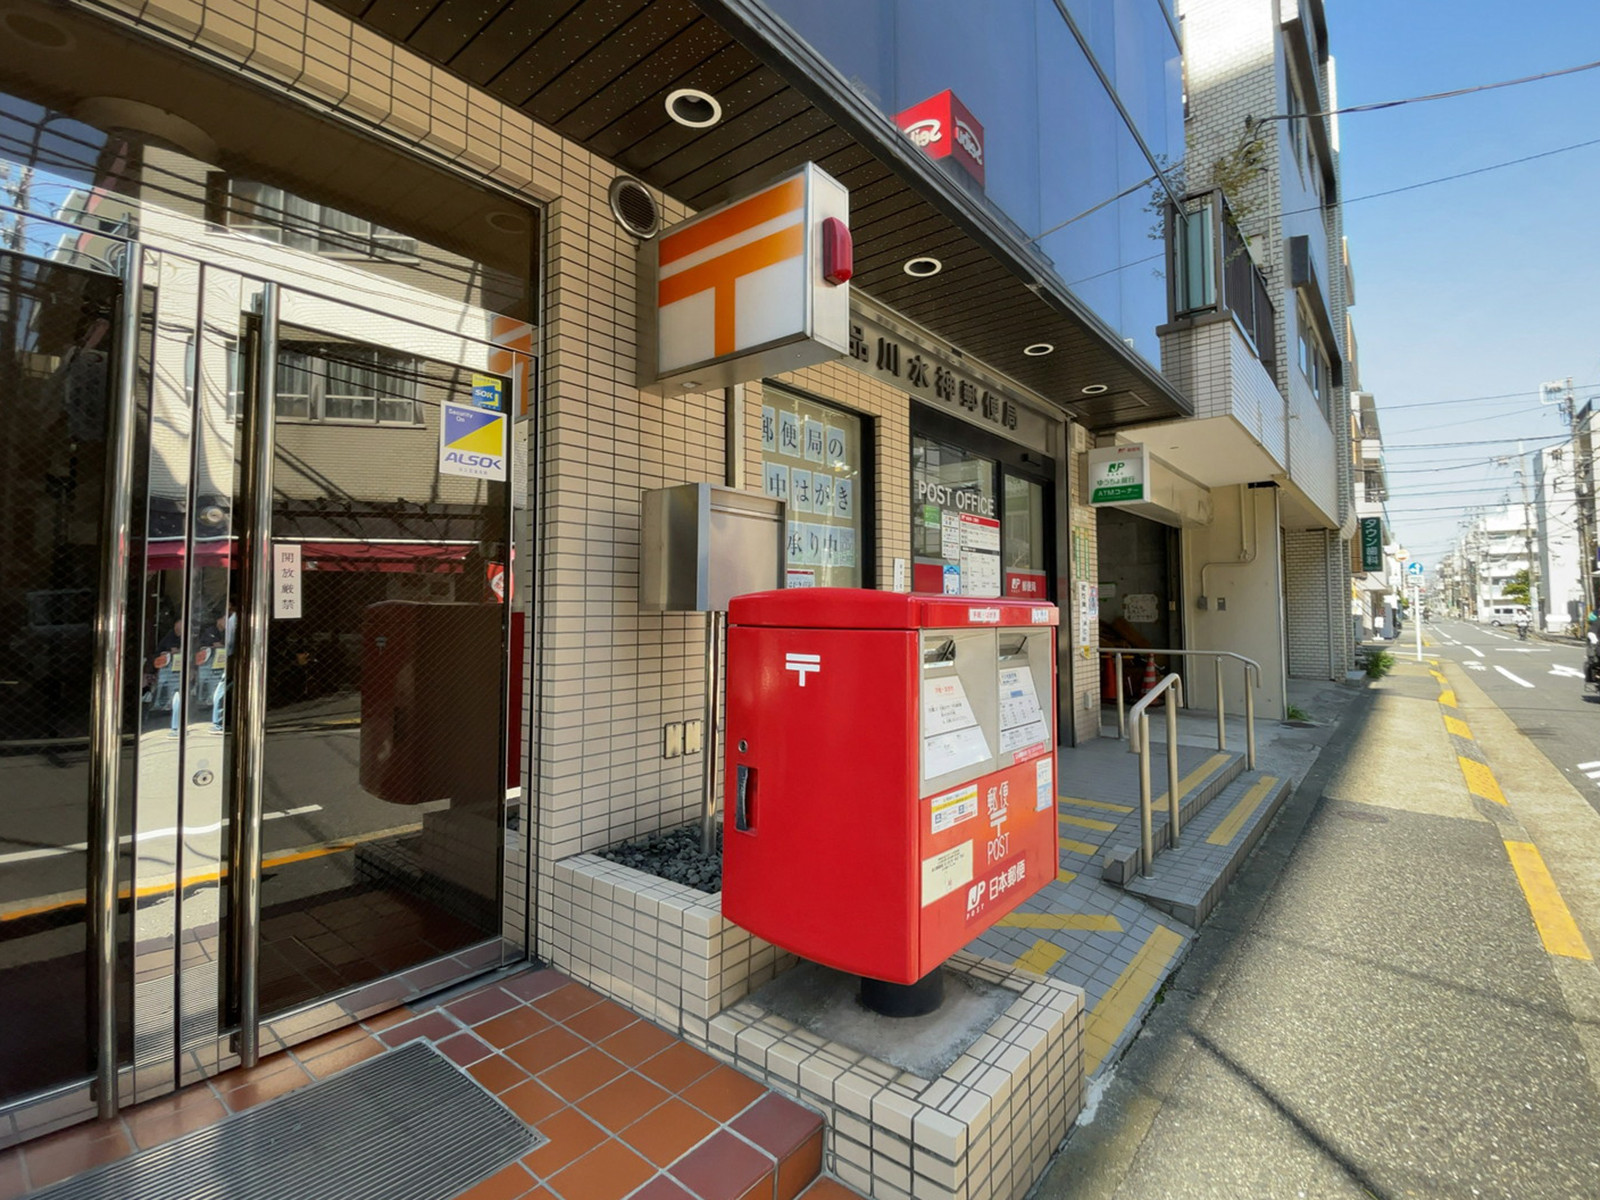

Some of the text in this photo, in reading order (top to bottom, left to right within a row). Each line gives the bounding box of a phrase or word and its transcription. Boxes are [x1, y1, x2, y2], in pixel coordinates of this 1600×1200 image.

[445, 452, 502, 470] ALSOK
[918, 480, 994, 516] POST OFFICE
[281, 552, 295, 609] 開放厳禁
[987, 781, 1009, 814] 郵便
[987, 832, 1010, 865] POST
[989, 859, 1026, 901] 日本郵便
[966, 903, 985, 920] POST
